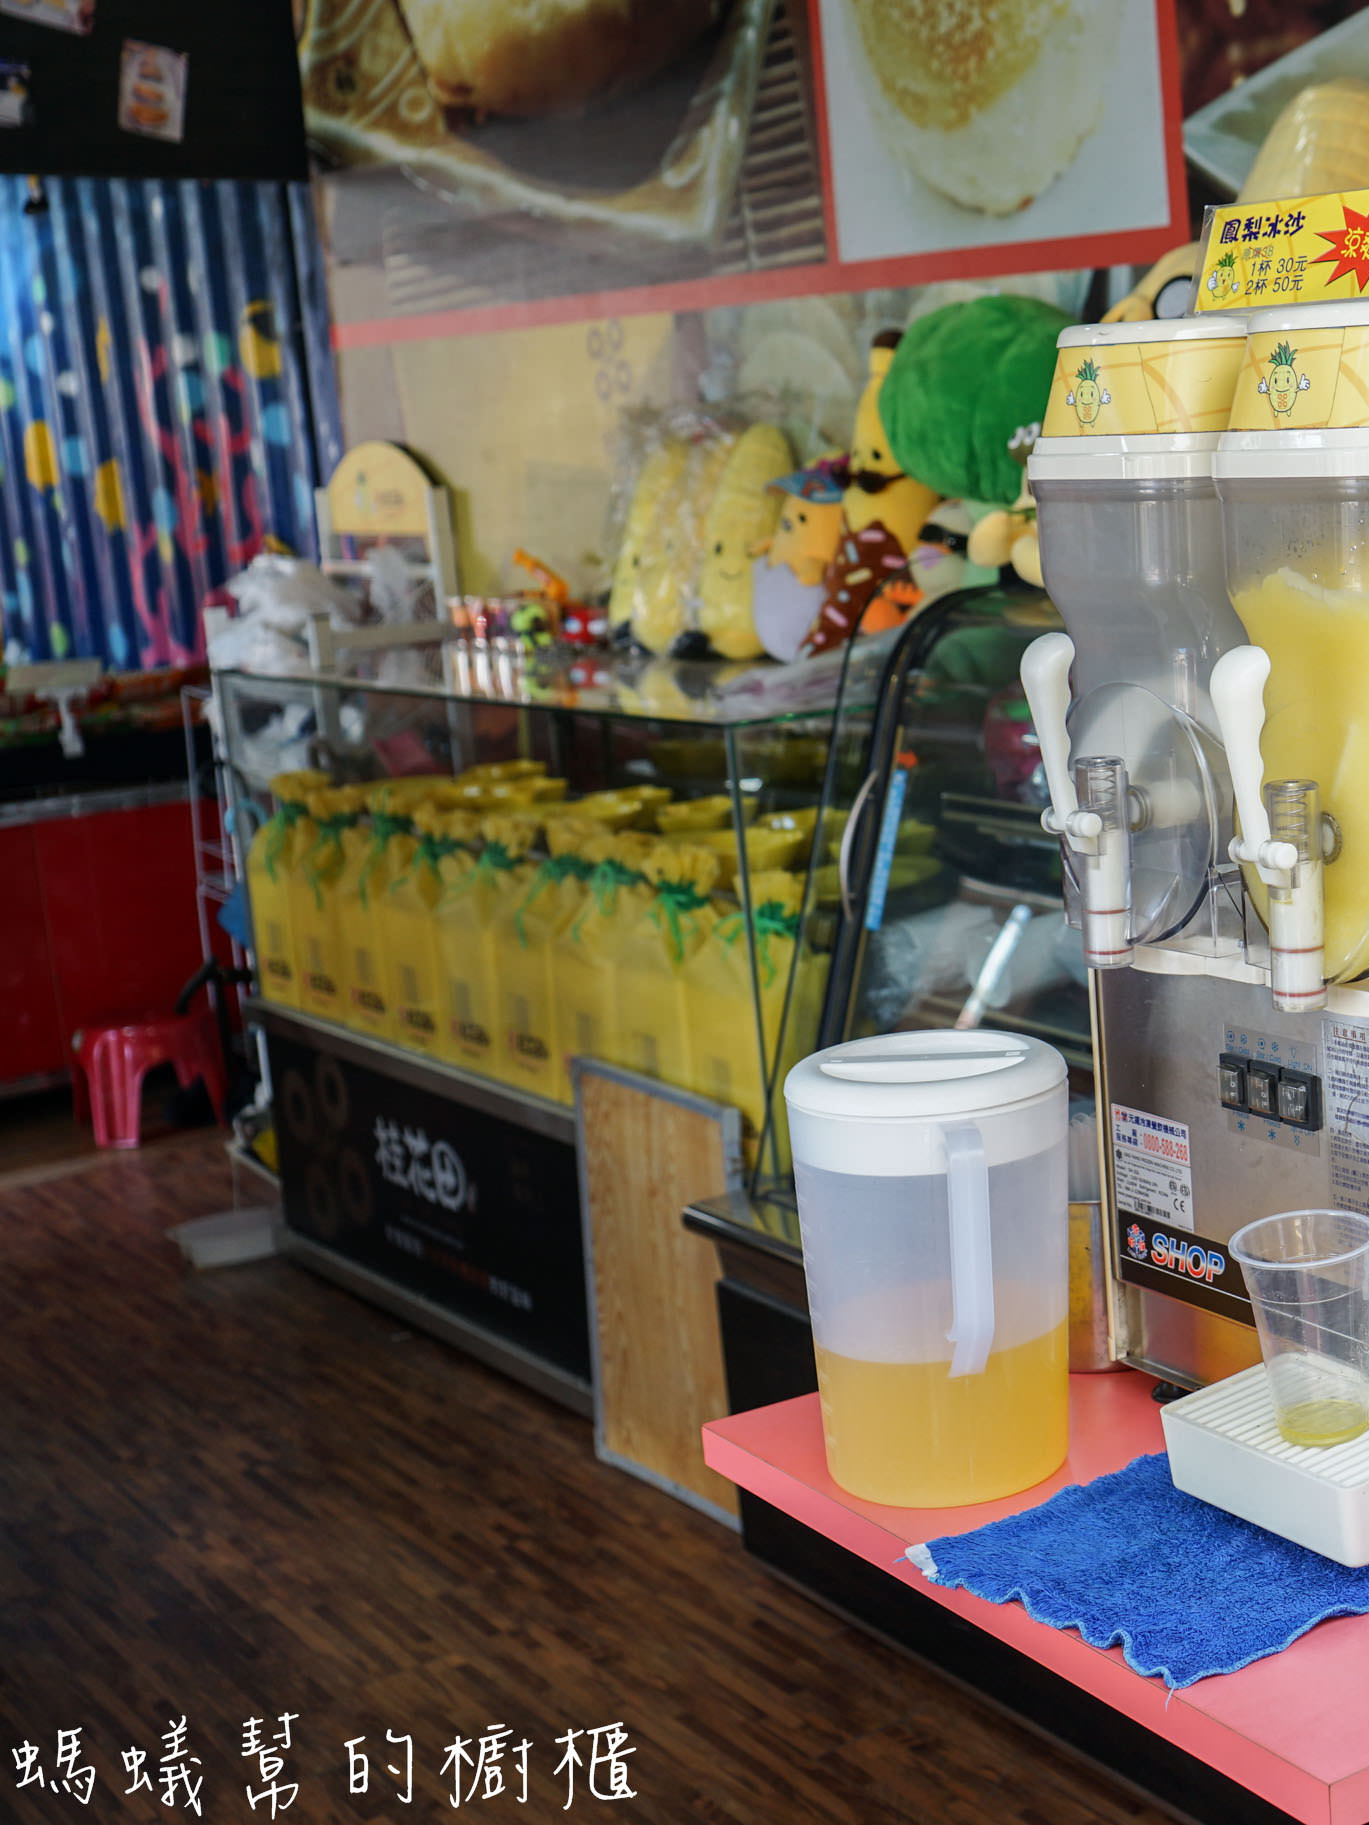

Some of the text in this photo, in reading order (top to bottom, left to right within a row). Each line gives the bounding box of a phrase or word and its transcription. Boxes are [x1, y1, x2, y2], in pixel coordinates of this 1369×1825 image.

[1219, 211, 1307, 244] 鳳梨冰沙
[1151, 1232, 1226, 1283] SHOP
